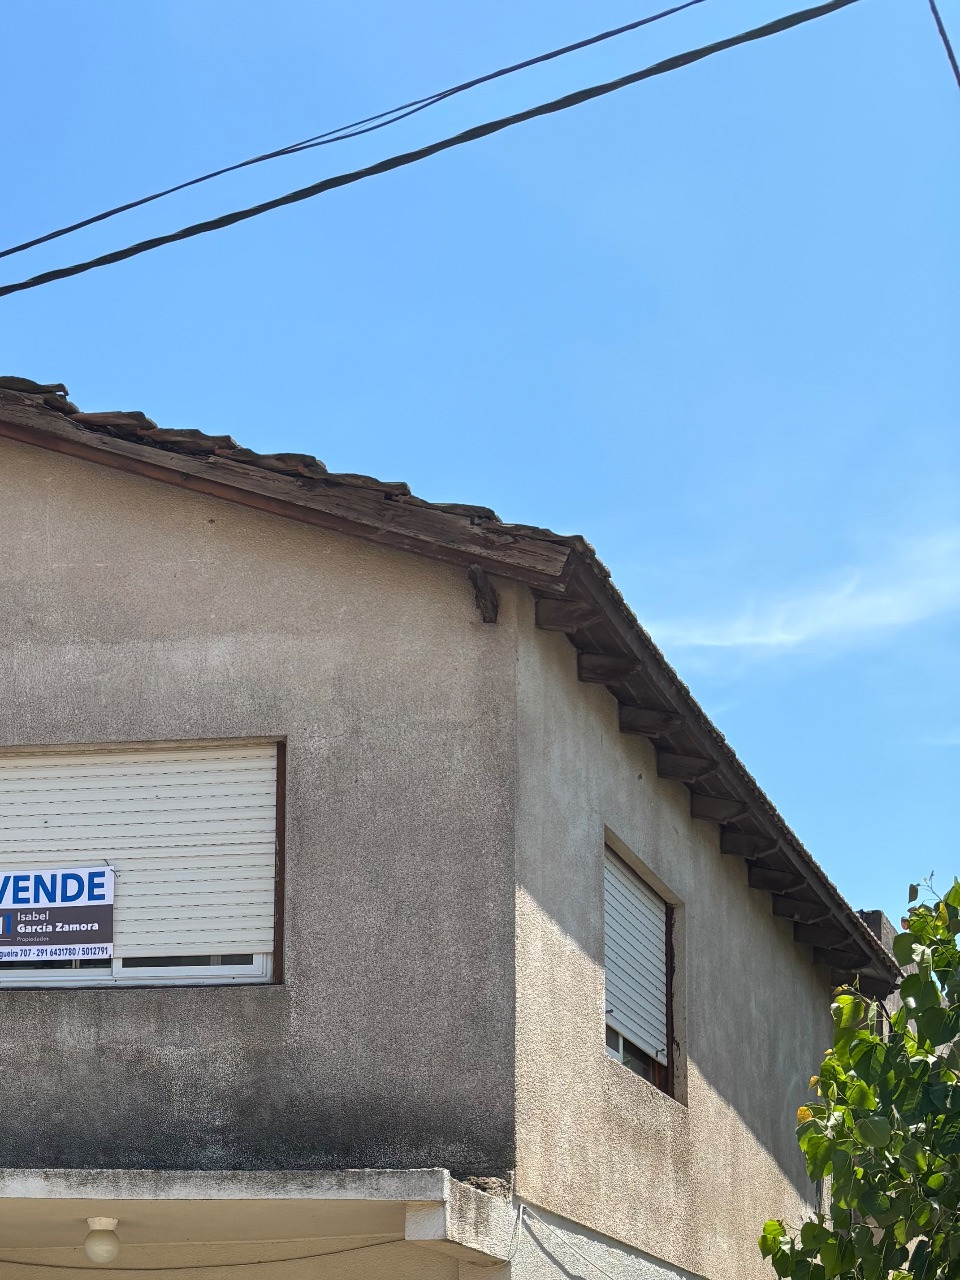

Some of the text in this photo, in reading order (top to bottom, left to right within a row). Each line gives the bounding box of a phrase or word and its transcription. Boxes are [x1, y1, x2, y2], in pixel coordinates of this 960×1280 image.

[17, 911, 49, 921] Isabel
[17, 922, 99, 933] García Zamora
[19, 949, 32, 958] 707
[36, 948, 48, 957] 291
[50, 947, 77, 957] 6431780
[81, 946, 108, 955] 5012791
